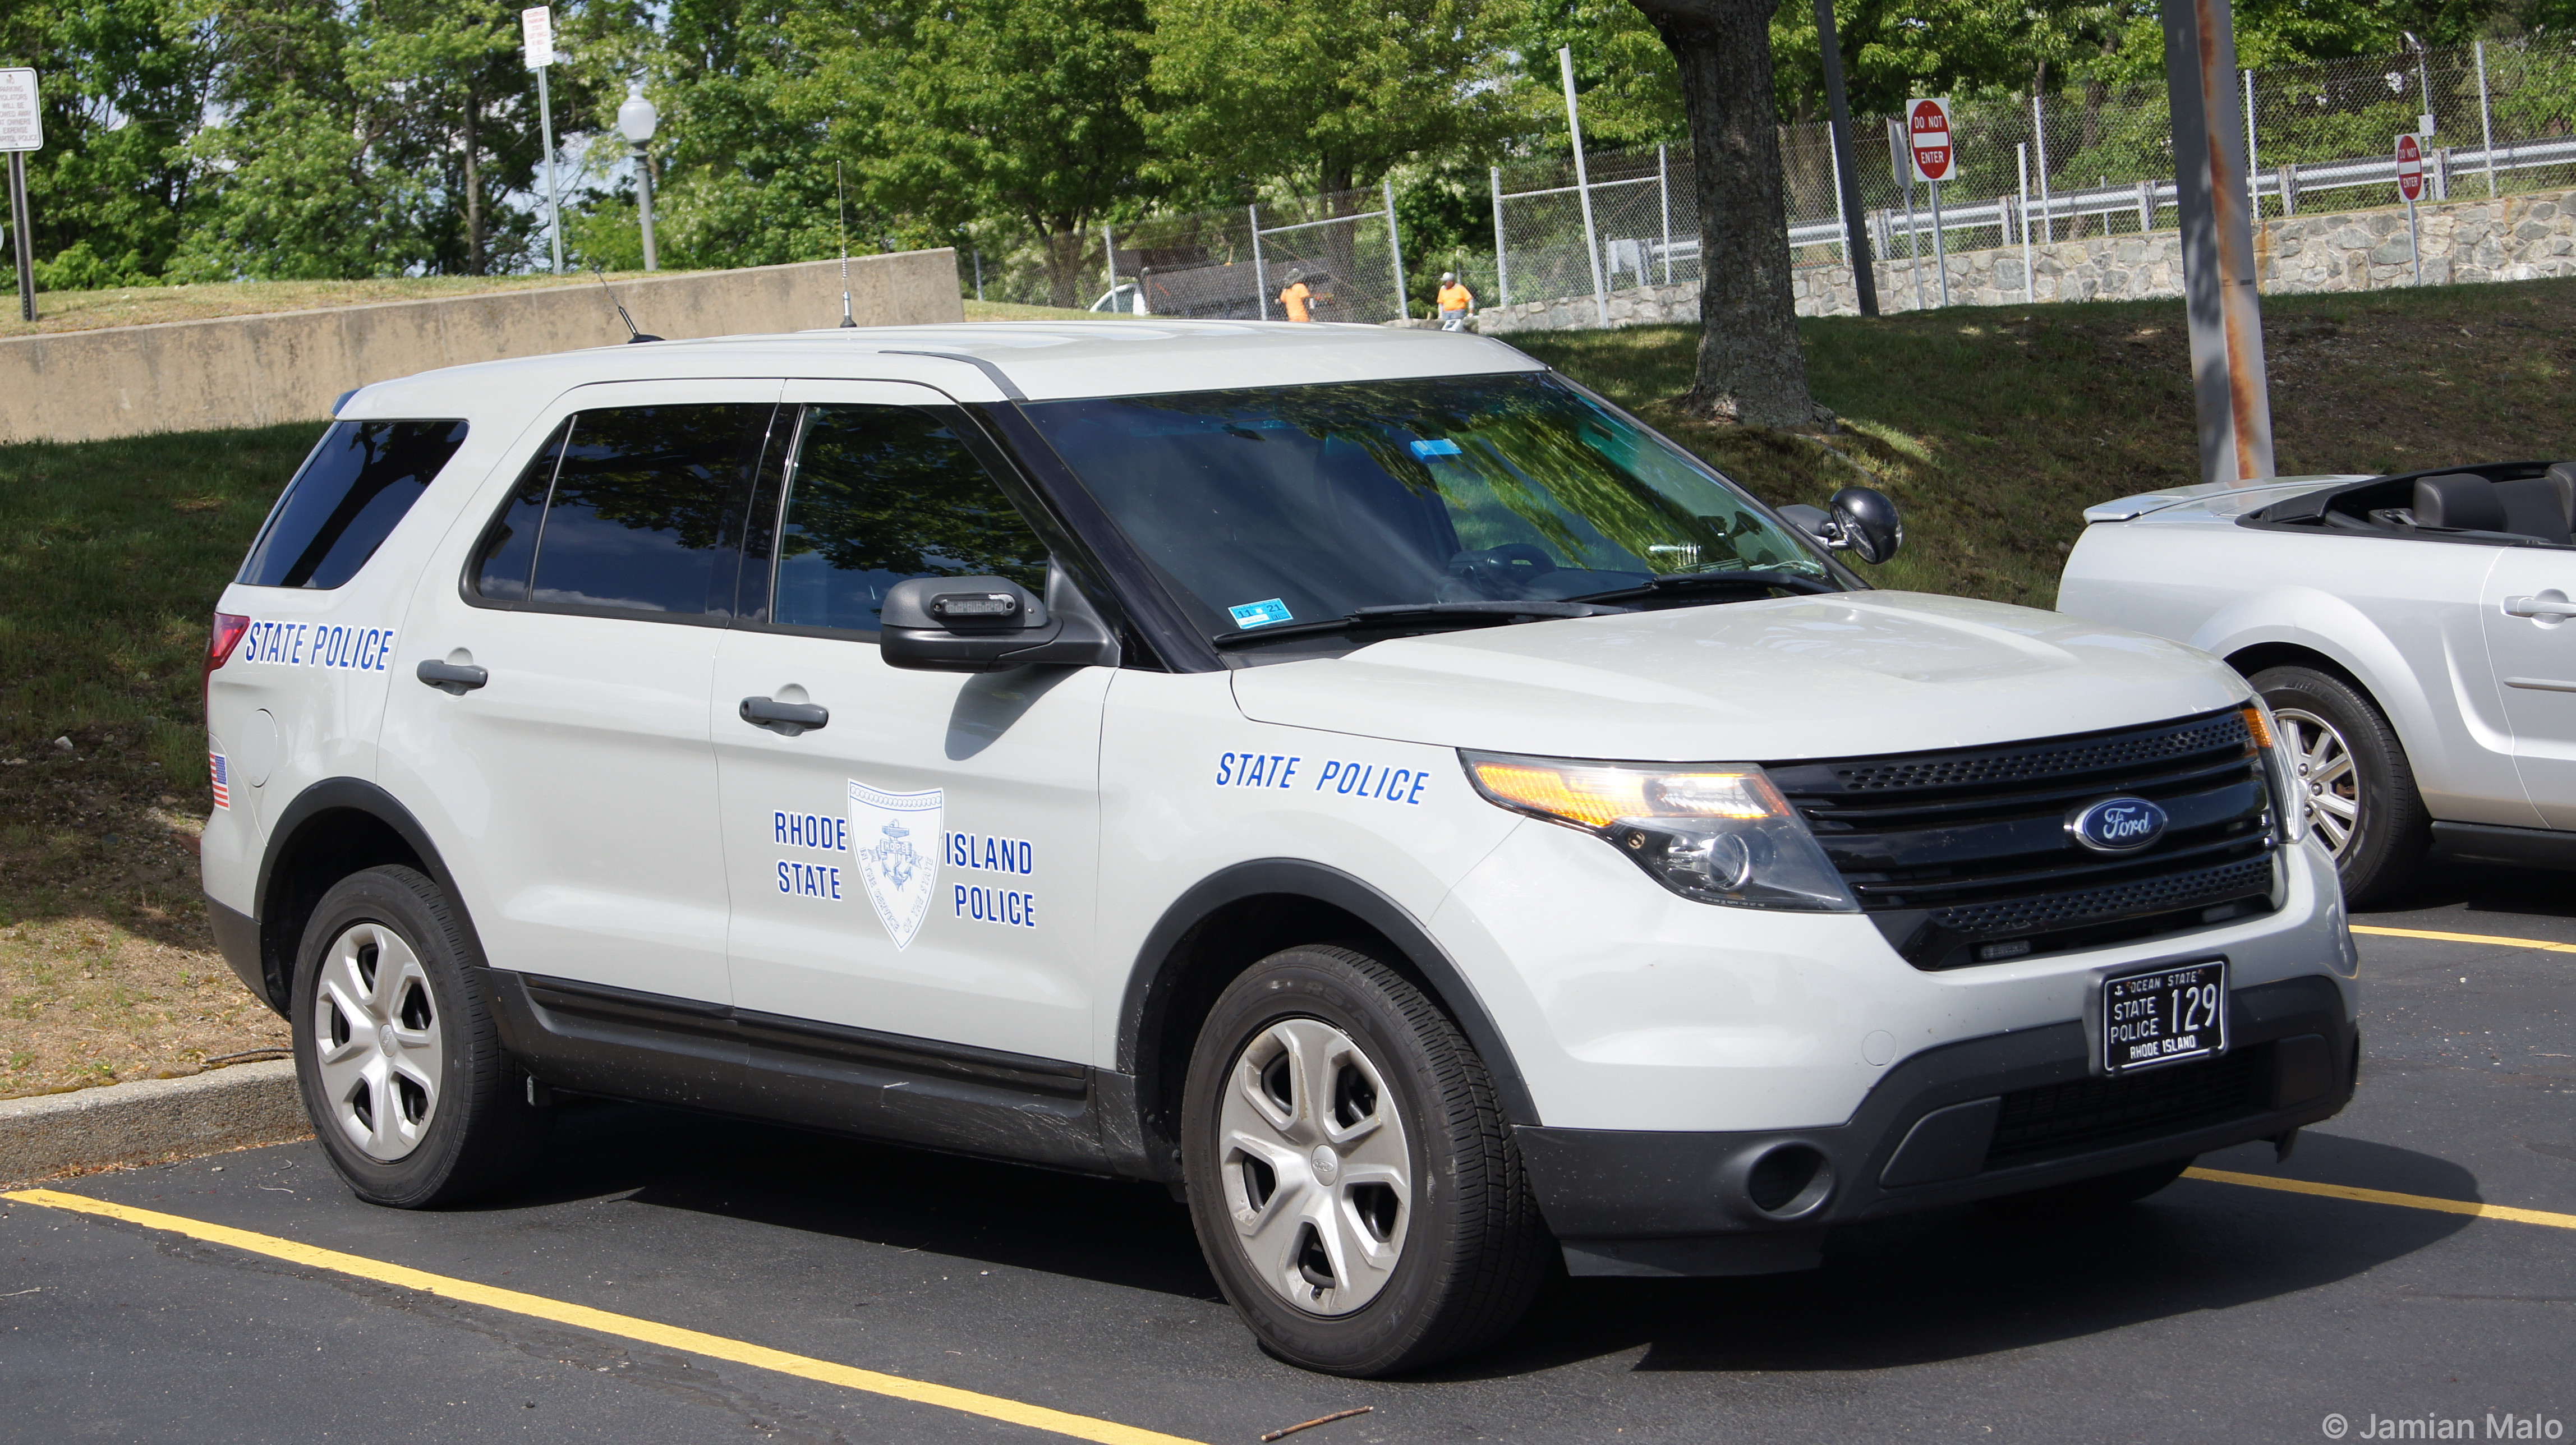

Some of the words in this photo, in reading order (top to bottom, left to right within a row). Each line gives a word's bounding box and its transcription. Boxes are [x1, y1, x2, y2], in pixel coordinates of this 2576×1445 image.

[1914, 116, 1924, 129] DO
[1928, 115, 1943, 128] NOT
[1920, 150, 1945, 164] ENTER
[2399, 149, 2405, 159] DO
[2407, 147, 2417, 158] NOT
[2403, 176, 2418, 188] ENTER
[1238, 609, 1254, 618] 11
[1266, 603, 1282, 613] 21
[245, 620, 308, 665] STATE
[310, 624, 394, 672] POLICE
[1216, 752, 1301, 789] STATE
[1315, 760, 1430, 805] POLICE
[774, 811, 847, 852] RHODE
[2103, 806, 2151, 839] Ford
[885, 841, 906, 853] HOPE
[945, 831, 1033, 875] ISLAND
[776, 859, 841, 901] STATE
[903, 917, 913, 933] OF
[910, 894, 924, 917] THE
[921, 857, 933, 894] STATE
[864, 862, 877, 889] THE
[874, 888, 900, 932] SERVICE
[954, 882, 1036, 929] POLICE
[2131, 977, 2161, 993] OCEAN
[2167, 970, 2198, 987] STATE
[2114, 996, 2156, 1021] STATE
[2172, 983, 2217, 1034] 129
[2110, 1017, 2159, 1044] POLICE
[2130, 1041, 2159, 1059] RHODE
[2162, 1034, 2197, 1053] ISLAND
